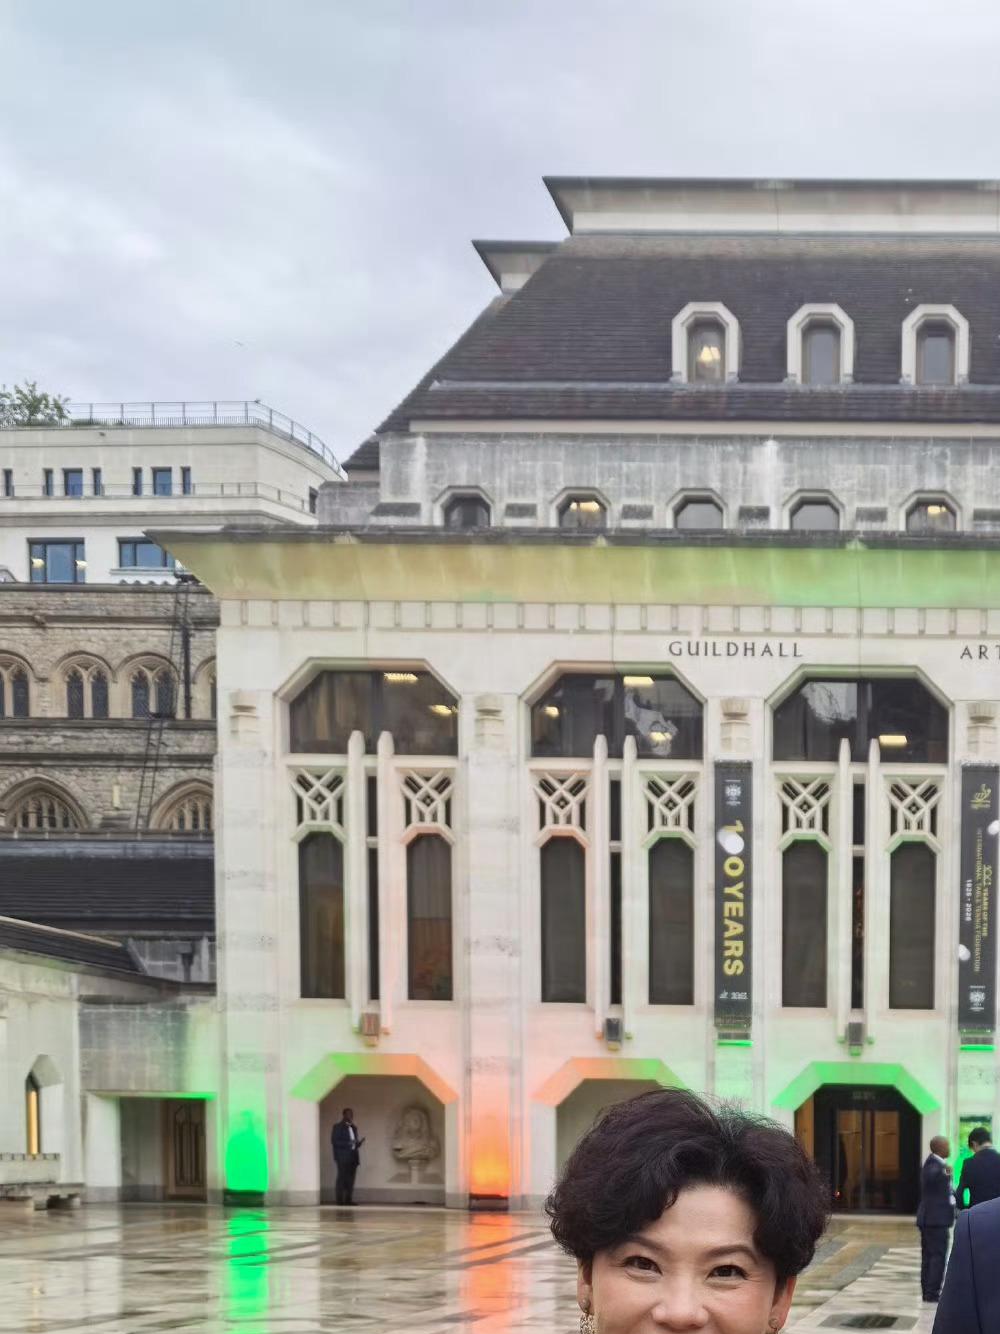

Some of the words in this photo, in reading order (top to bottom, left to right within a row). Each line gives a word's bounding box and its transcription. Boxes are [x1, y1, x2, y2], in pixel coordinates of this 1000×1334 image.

[668, 641, 803, 657] GUILDHALL
[723, 820, 745, 877] 10
[723, 881, 745, 976] YEARS
[965, 903, 973, 921] 2026
